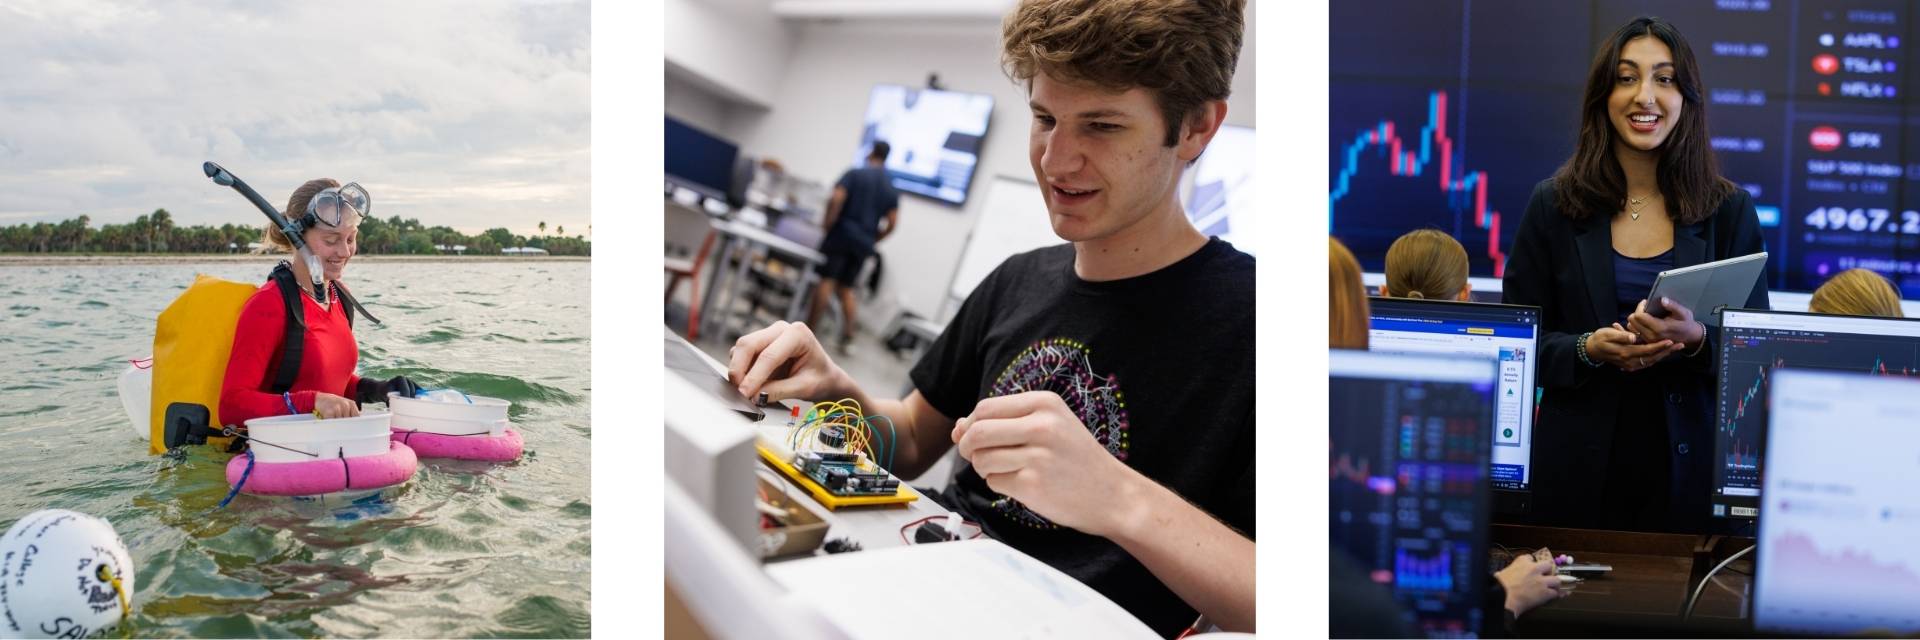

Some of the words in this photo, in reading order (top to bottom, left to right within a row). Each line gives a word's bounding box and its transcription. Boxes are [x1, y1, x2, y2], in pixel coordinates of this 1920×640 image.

[1843, 33, 1884, 48] AAPL
[1843, 57, 1883, 73] TSLA
[1841, 82, 1883, 97] NFLX
[1848, 132, 1880, 147] SPX
[1865, 163, 1902, 176] Index
